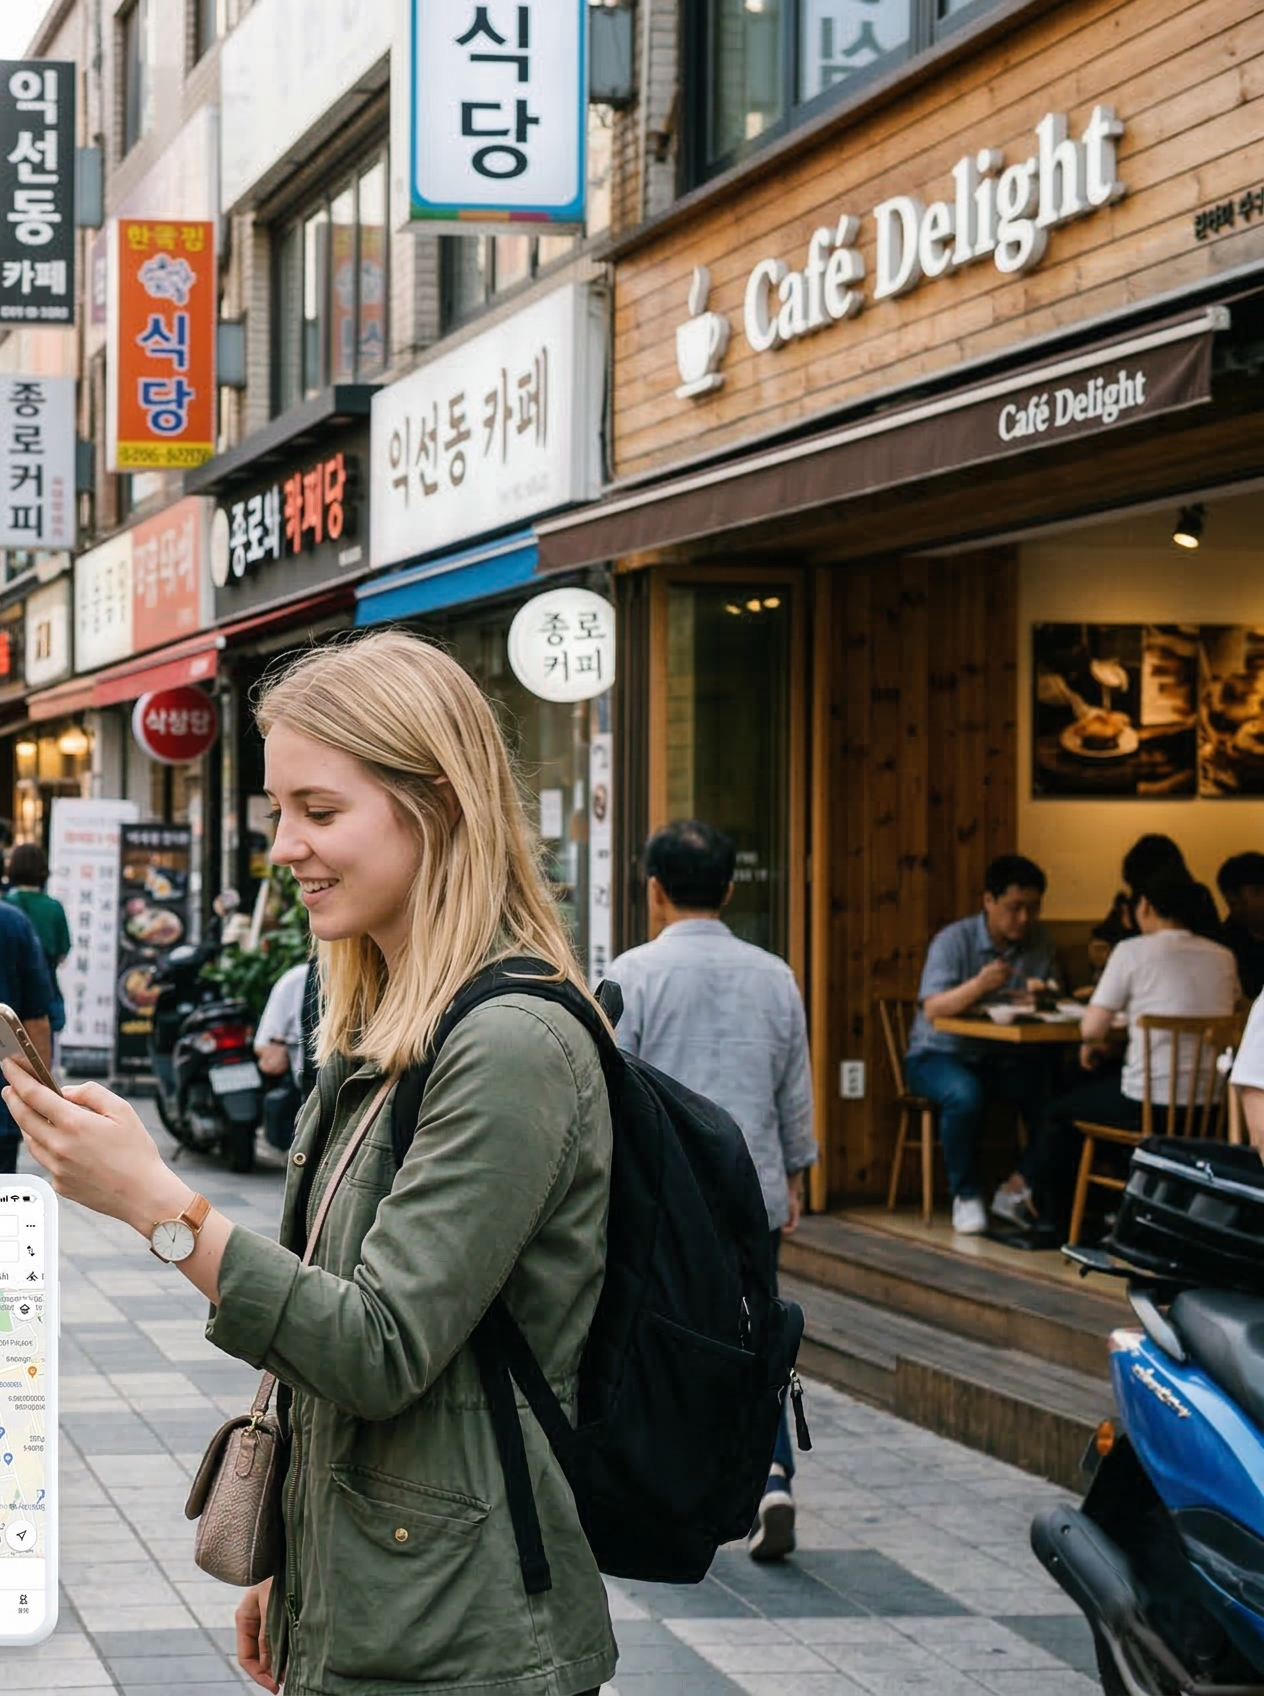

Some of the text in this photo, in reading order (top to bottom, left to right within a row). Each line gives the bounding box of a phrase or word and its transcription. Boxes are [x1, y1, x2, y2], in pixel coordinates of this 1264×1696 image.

[7, 69, 62, 246] 익선동
[456, 6, 540, 179] 식당
[2, 259, 66, 295] 카페
[743, 104, 1129, 353] Café Delight
[136, 312, 196, 436] 식당
[388, 345, 548, 508] 익선동 카페
[998, 370, 1147, 442] Café Delight
[8, 382, 47, 540] 종로커피
[539, 612, 606, 646] 종로
[543, 649, 602, 681] 커피
